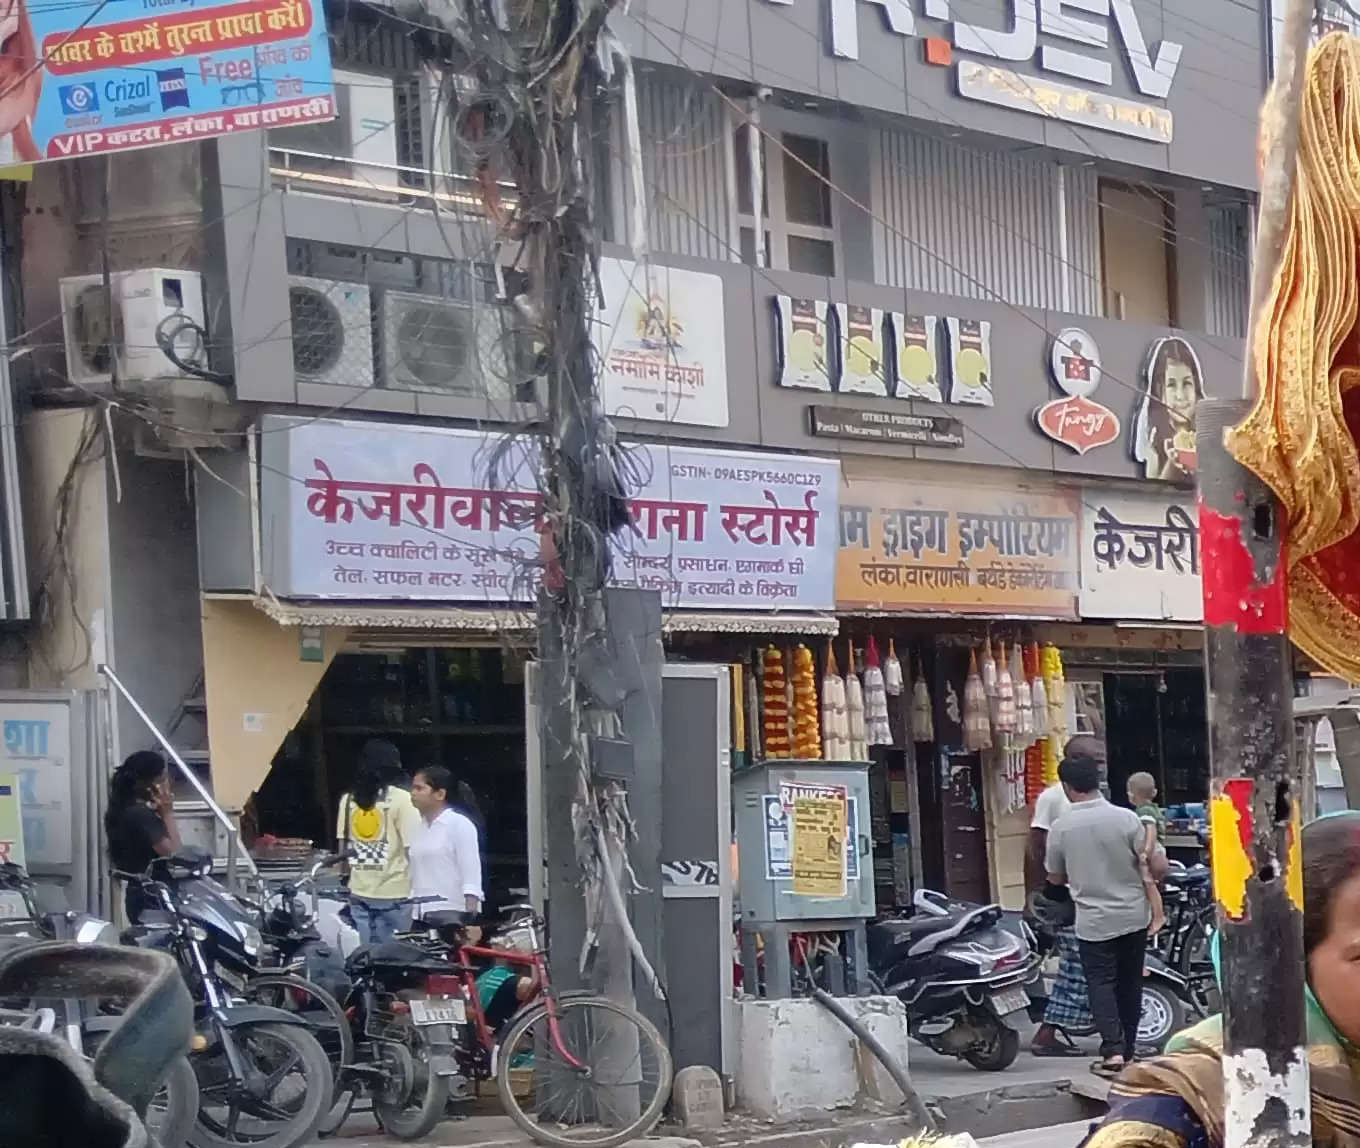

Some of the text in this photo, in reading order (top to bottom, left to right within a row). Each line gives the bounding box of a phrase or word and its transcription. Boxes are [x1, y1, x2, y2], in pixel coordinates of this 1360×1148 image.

[95, 31, 115, 58] के
[198, 55, 251, 85] Free
[104, 75, 151, 102] Crizal
[54, 132, 104, 155] VIP
[235, 98, 330, 127] वाराणसी
[816, 421, 839, 433] Pasta
[862, 412, 890, 424] OTHER
[627, 499, 709, 542] राना
[720, 489, 820, 548] स्टोर्स
[1094, 505, 1200, 576] केजरी
[374, 568, 423, 587] सफल
